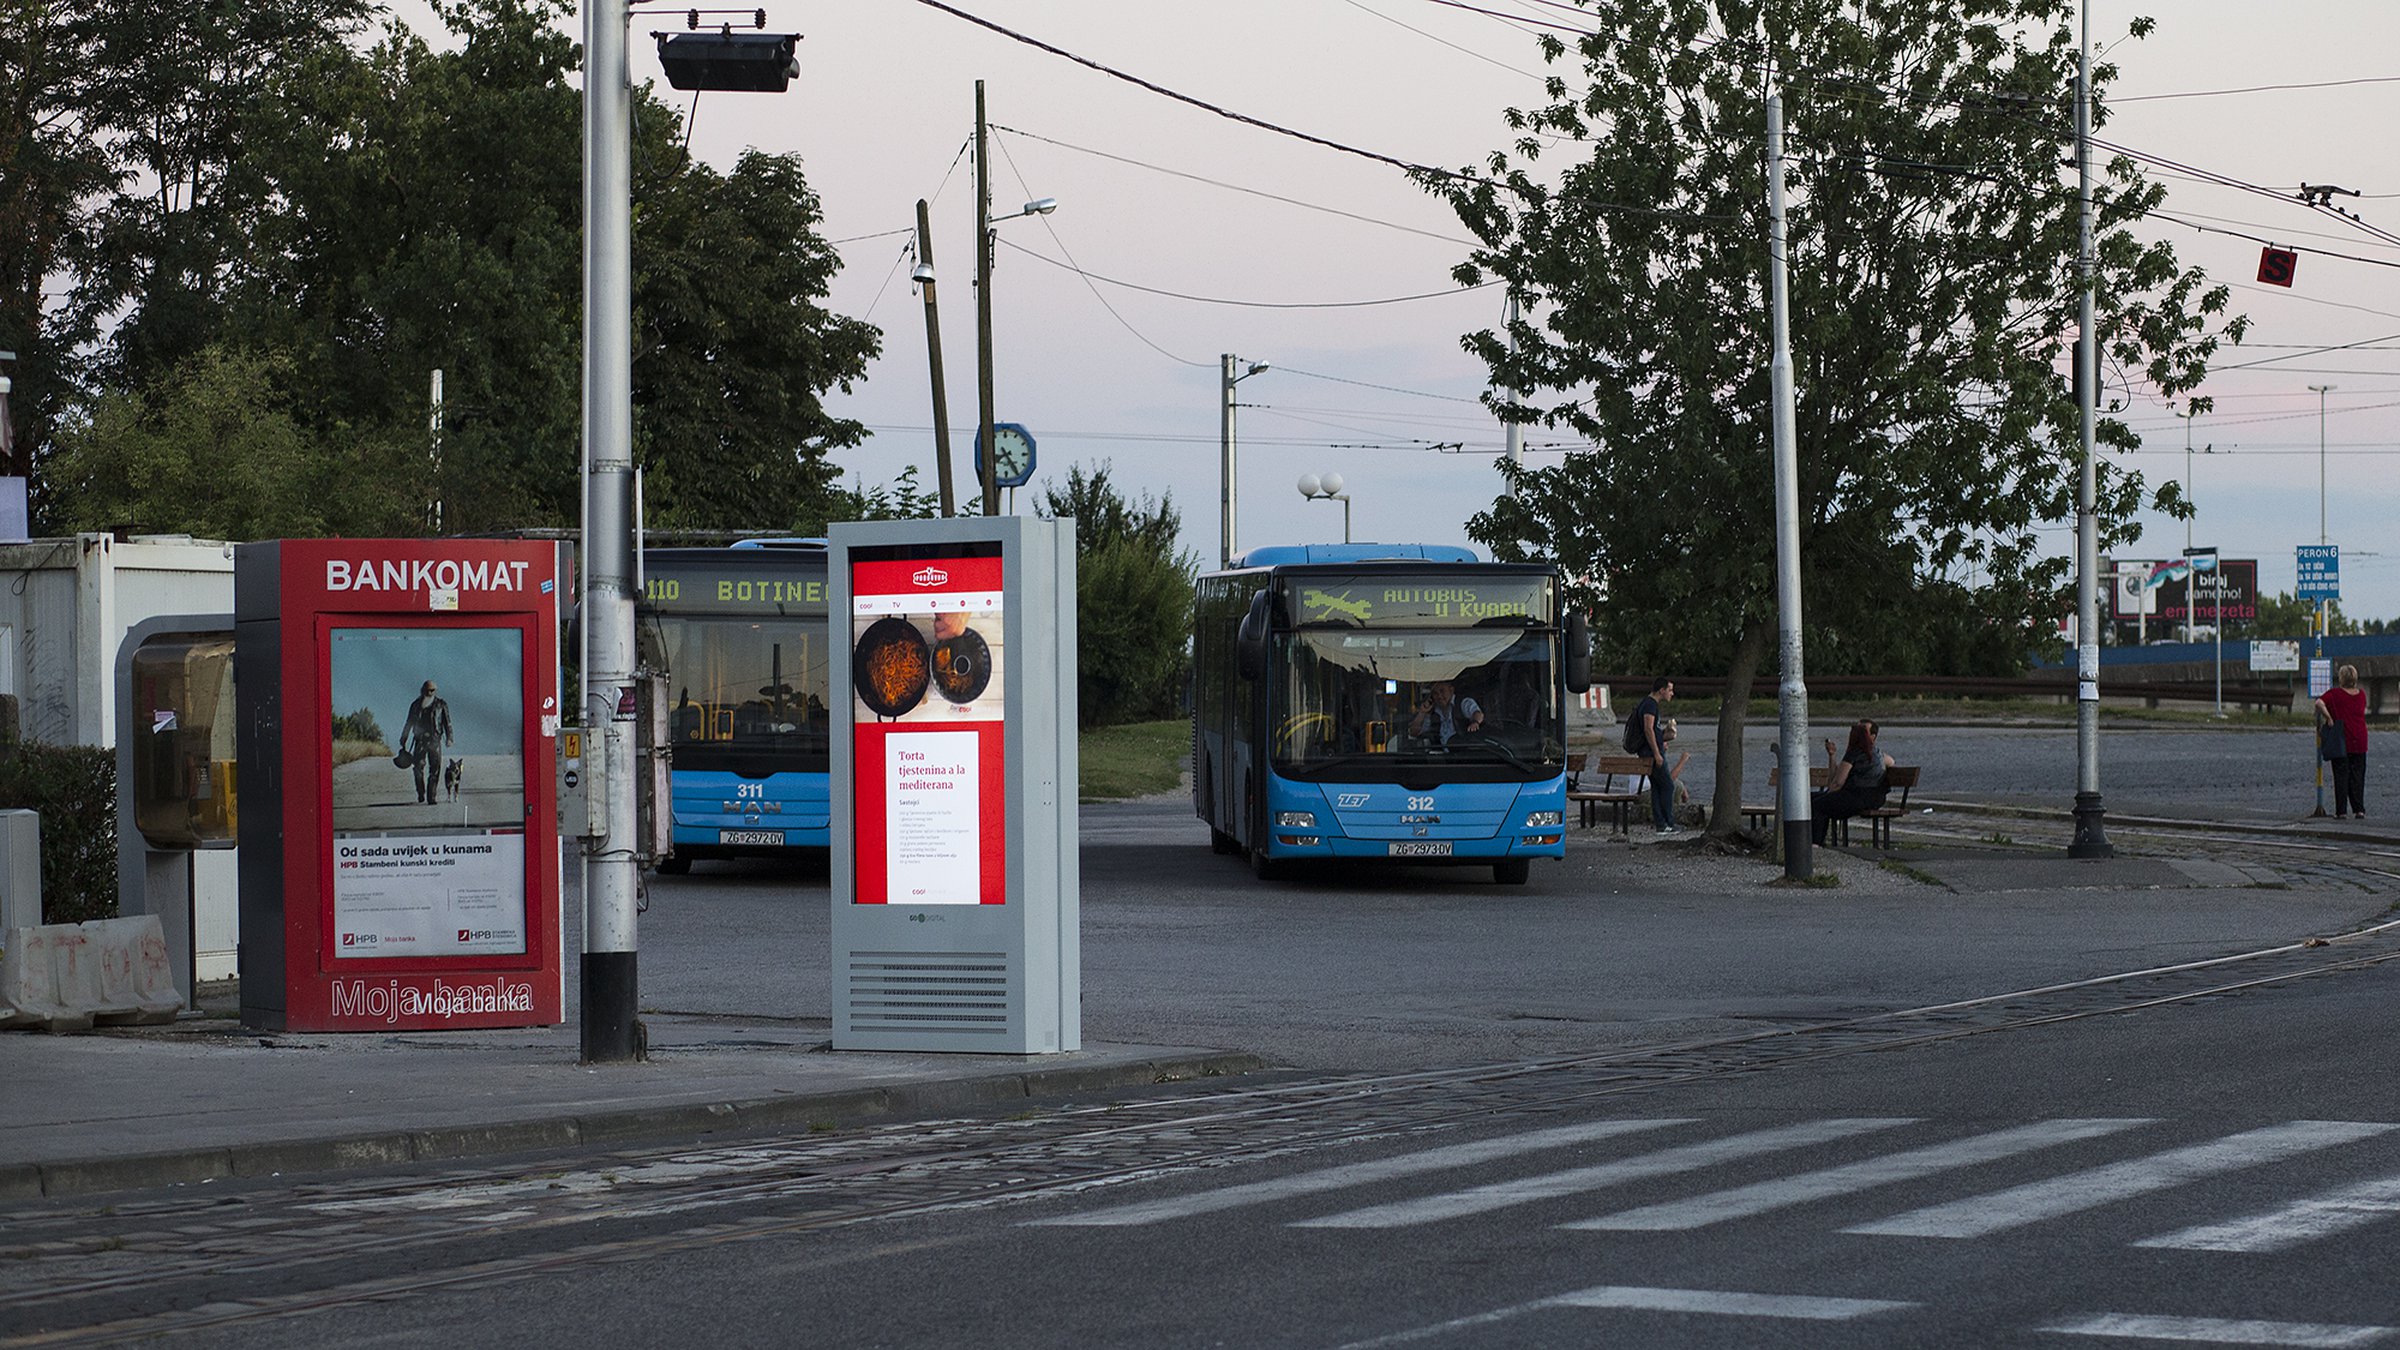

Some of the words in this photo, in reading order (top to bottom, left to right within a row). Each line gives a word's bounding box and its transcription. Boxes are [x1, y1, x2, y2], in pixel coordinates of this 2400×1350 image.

[2265, 253, 2290, 282] S
[2298, 548, 2329, 558] PERON
[2331, 547, 2337, 558] 6
[326, 560, 529, 591] BANKOMAT
[647, 580, 681, 600] 110
[717, 580, 829, 602] BOTINE
[1383, 589, 1478, 603] AUTOBUS
[1435, 603, 1449, 617] U
[1460, 602, 1527, 617] KVARU
[899, 751, 925, 761] Torta
[898, 764, 947, 778] tjestenina
[949, 766, 954, 775] a
[957, 764, 966, 775] la
[737, 784, 763, 798] 311
[899, 779, 954, 791] mediterana
[723, 801, 782, 814] MAN
[1407, 796, 1434, 811] 312
[340, 846, 358, 858] Od
[361, 846, 389, 857] sada
[392, 845, 428, 858] uvijek
[431, 846, 440, 855] u
[443, 844, 492, 854] kunama
[1396, 843, 1408, 855] ZG
[340, 861, 358, 869] HPB
[360, 860, 398, 868] Stambeni
[400, 859, 428, 867] kunski
[429, 858, 455, 866] krediti
[355, 934, 377, 944] HPB
[470, 930, 491, 940] HPB
[332, 979, 420, 1024] Moja
